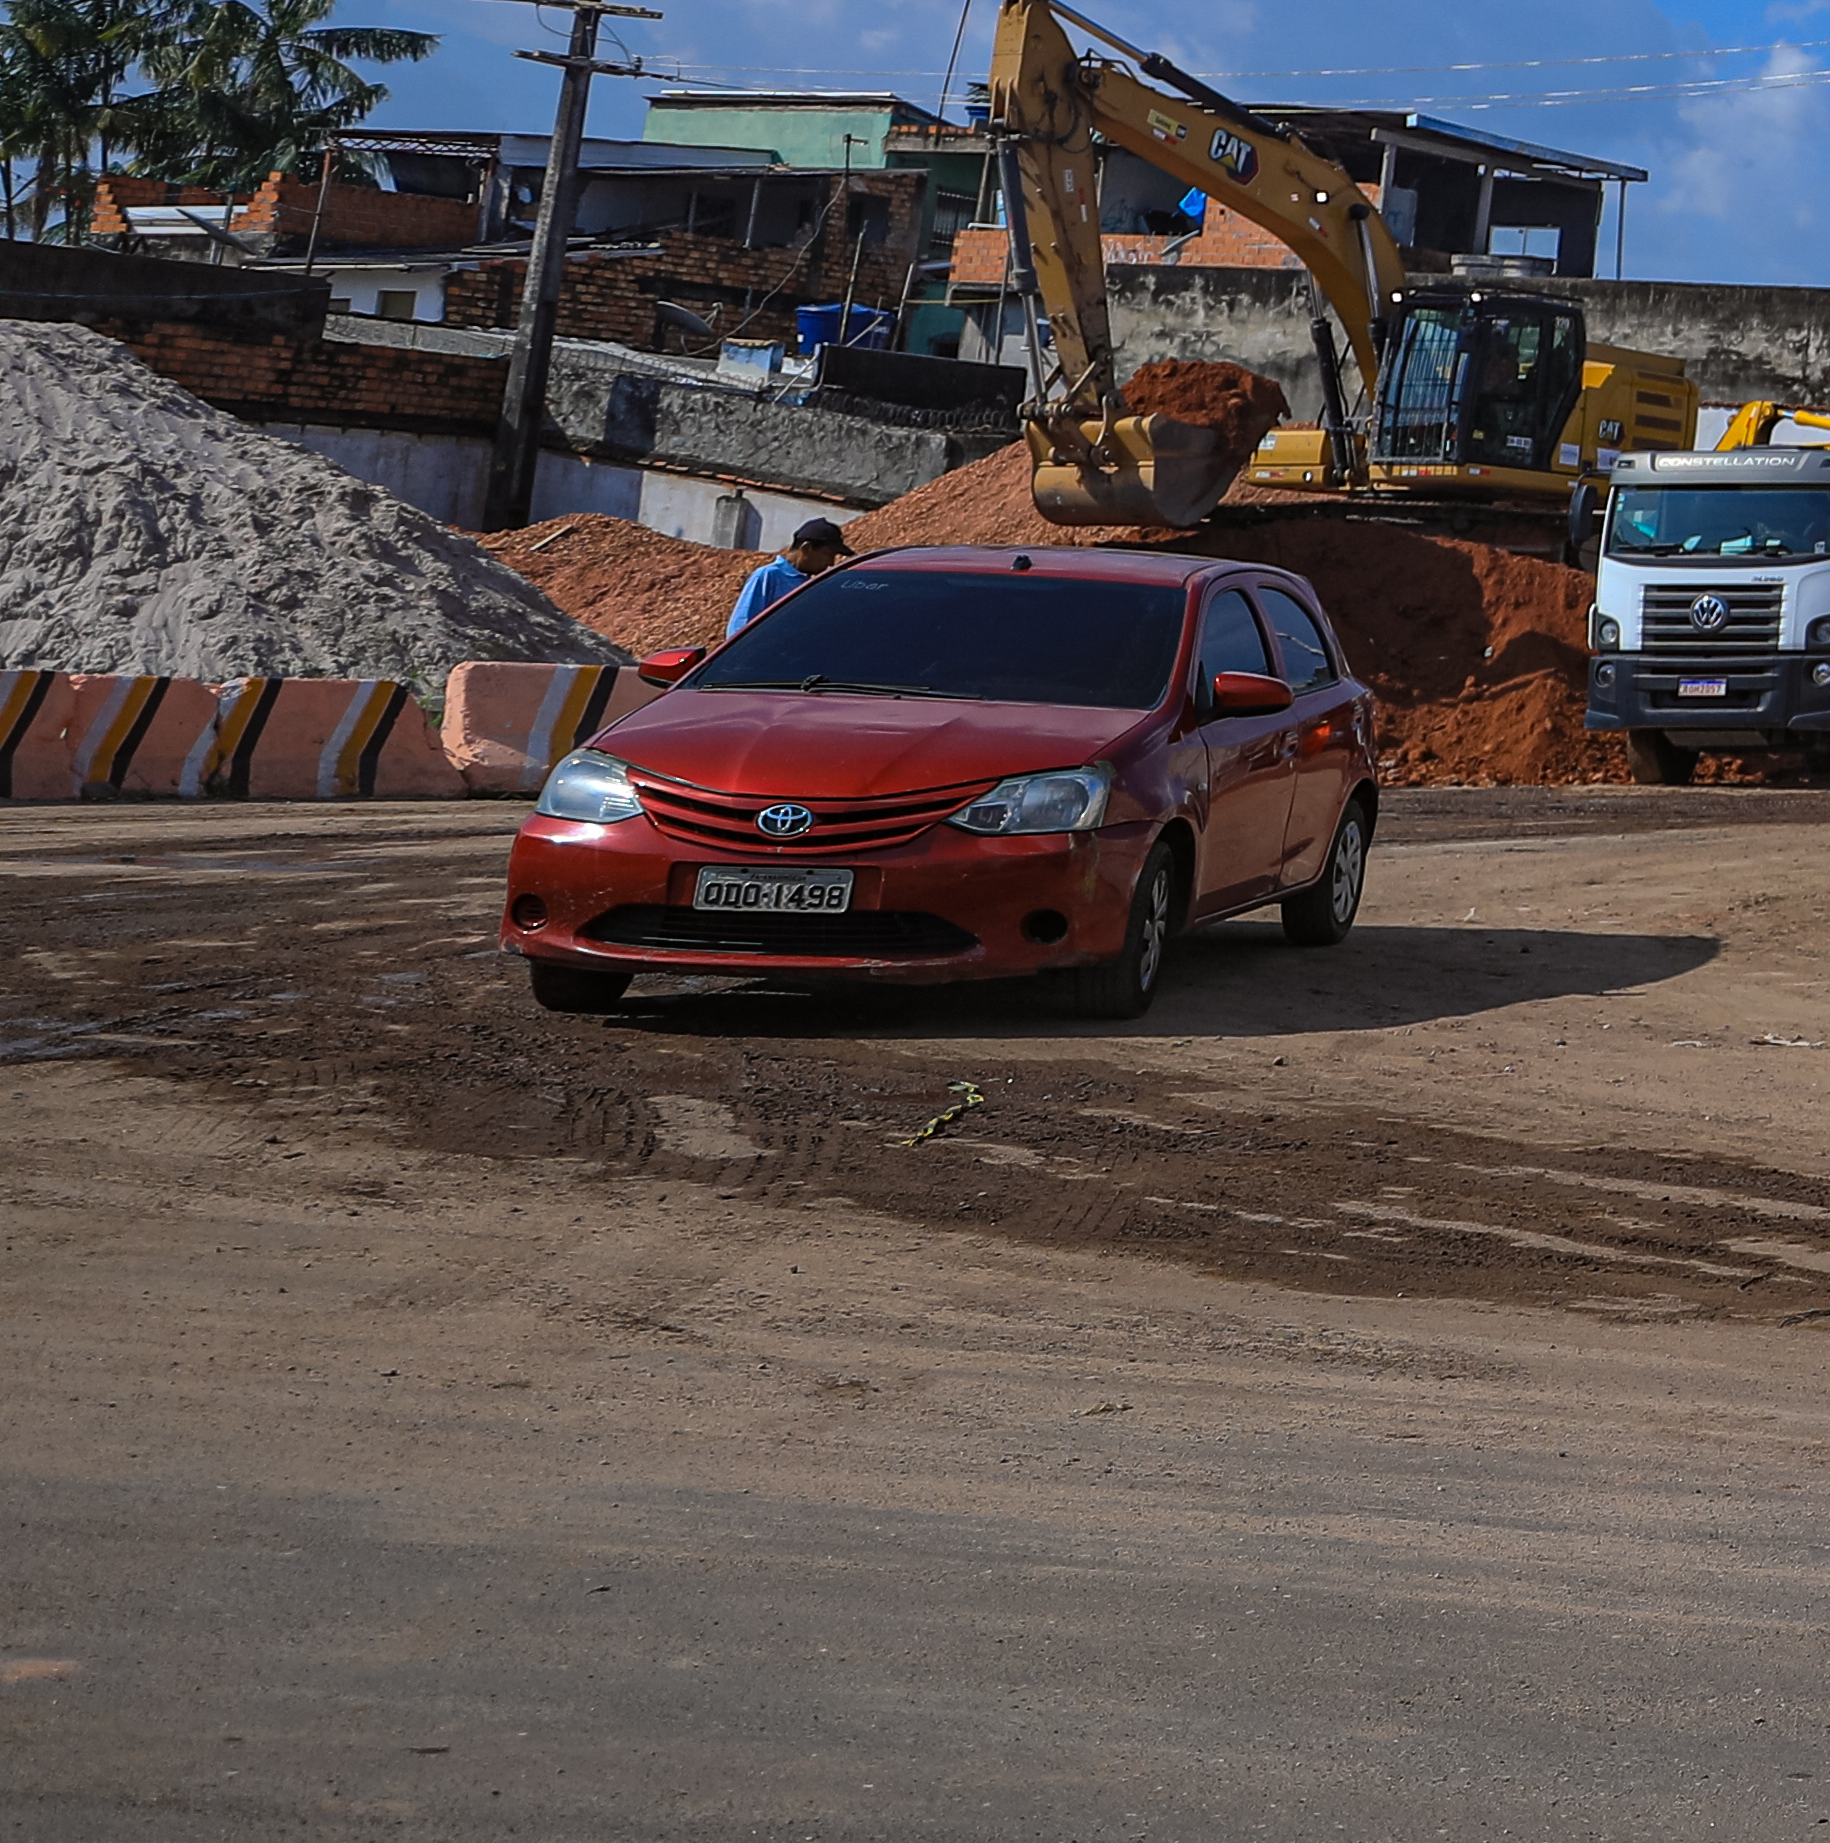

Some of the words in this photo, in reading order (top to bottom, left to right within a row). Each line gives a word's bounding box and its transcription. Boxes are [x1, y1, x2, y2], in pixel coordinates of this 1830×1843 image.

[1210, 128, 1251, 173] CAT
[1599, 420, 1621, 441] CAT
[1658, 456, 1796, 467] CONSTELLATION
